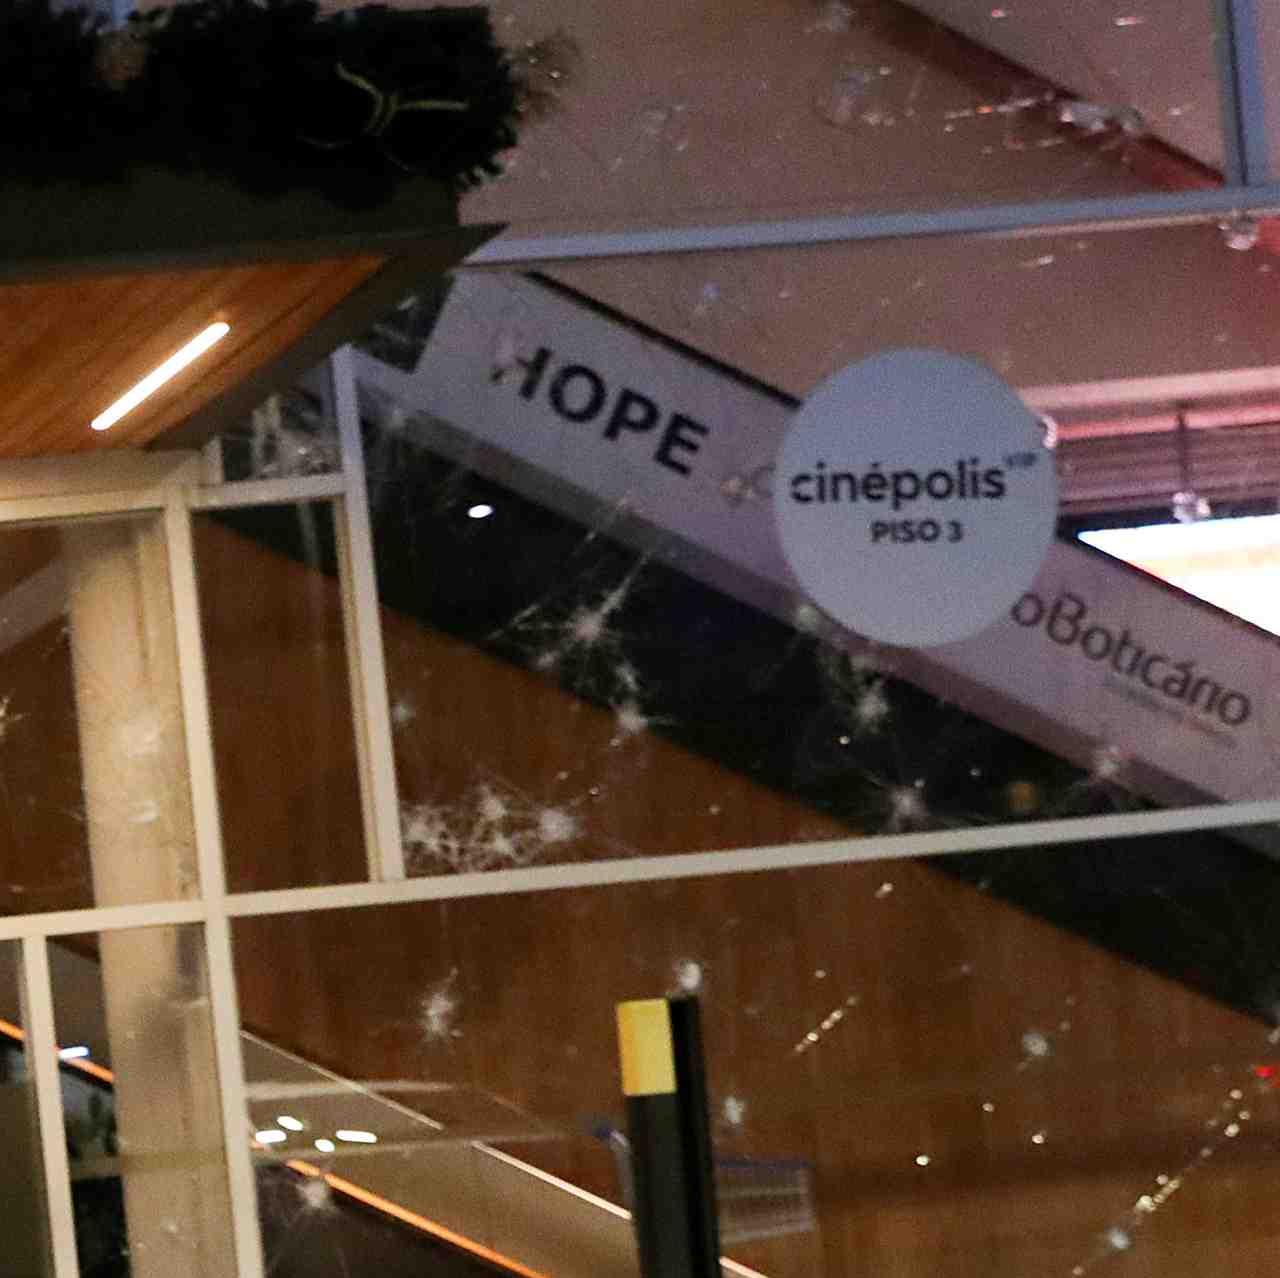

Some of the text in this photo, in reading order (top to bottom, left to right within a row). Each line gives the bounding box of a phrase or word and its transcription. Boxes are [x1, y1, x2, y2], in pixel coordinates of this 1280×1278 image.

[491, 347, 710, 476] HOPE
[790, 456, 1005, 510] cinépolis
[871, 518, 964, 543] PISO 3
